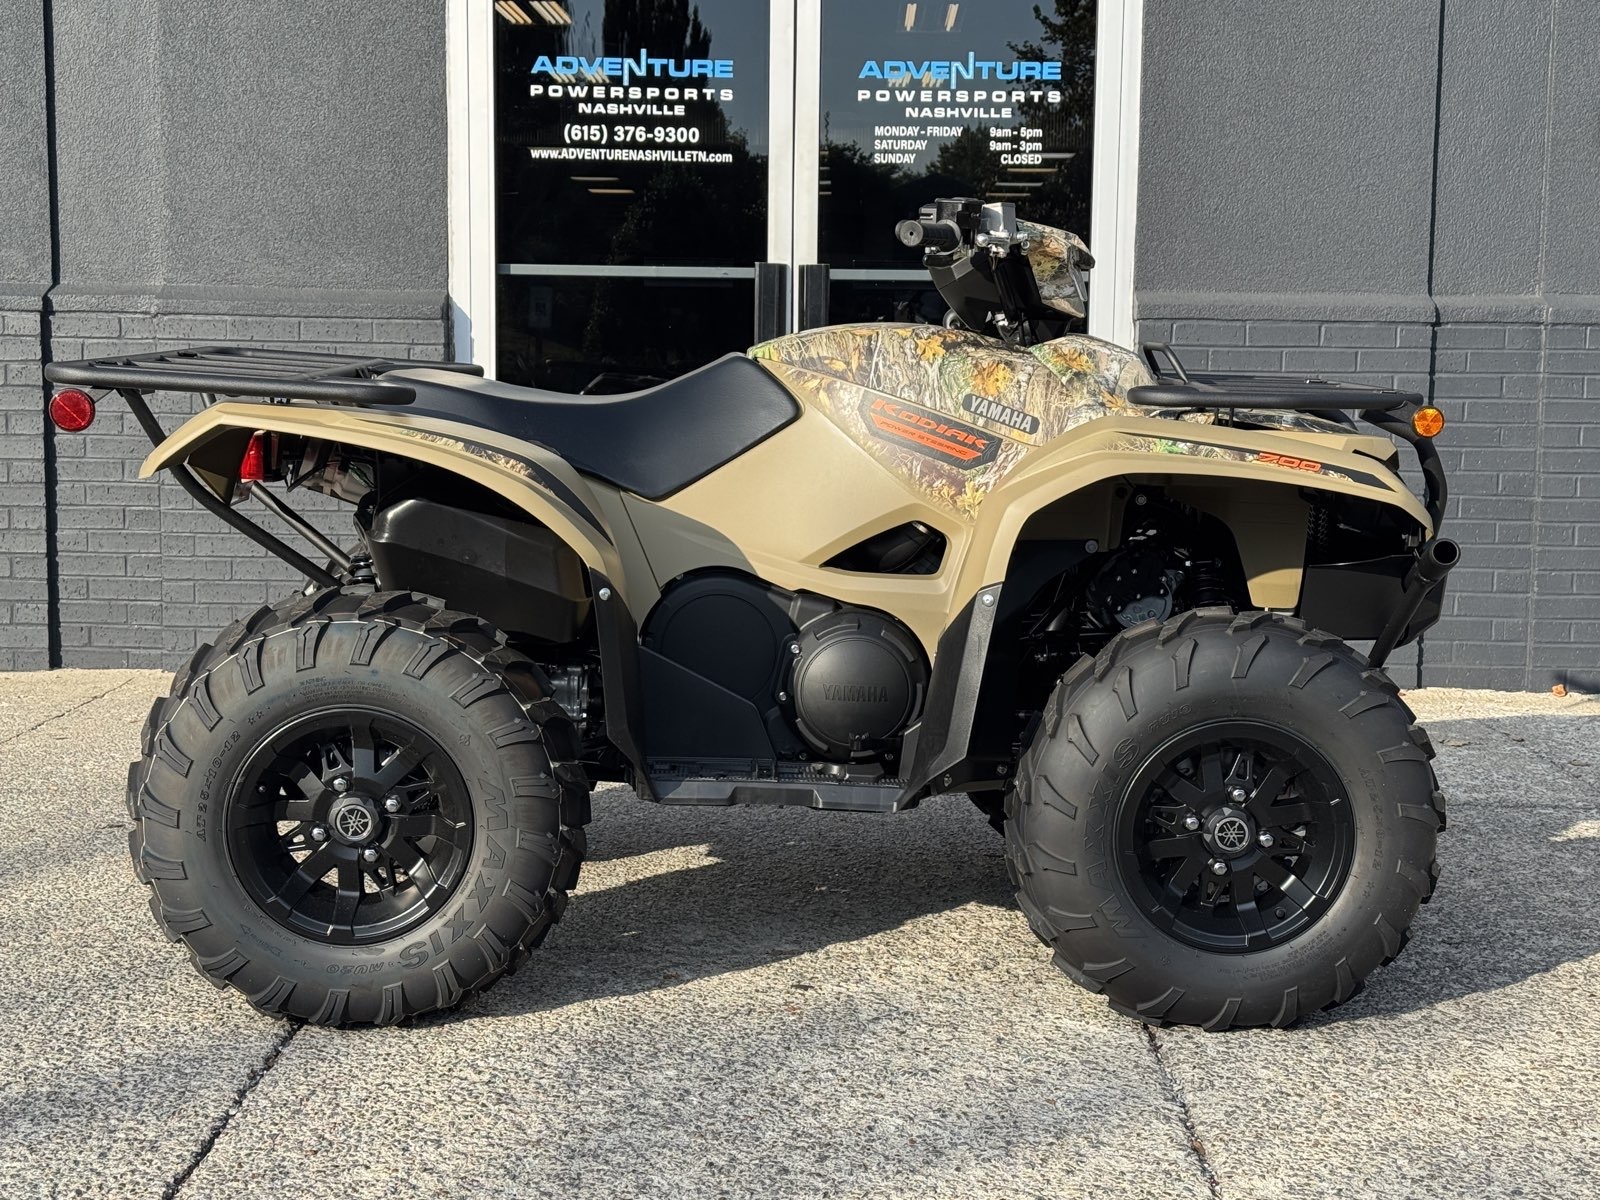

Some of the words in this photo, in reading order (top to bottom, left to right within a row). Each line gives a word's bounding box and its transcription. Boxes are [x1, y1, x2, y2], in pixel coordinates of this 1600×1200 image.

[531, 48, 733, 86] ADVENTURE
[858, 51, 1062, 89] ADVENTURE
[530, 84, 734, 101] POWERSPORTS
[857, 90, 1062, 103] POWERSPORTS
[578, 103, 686, 115] NASHVILLE
[905, 107, 1013, 118] NASHVILLE
[563, 123, 608, 144] (615)
[614, 126, 700, 143] 376-9300
[530, 148, 733, 163] www.ADVENTURENASHVILLETN.com
[874, 140, 928, 151] SATURDAY
[874, 153, 917, 164] SUNDAY
[1000, 154, 1042, 165] CLOSED
[871, 399, 990, 449] KODIAK
[970, 395, 1032, 433] YAMAHA
[880, 421, 916, 439] POWER
[917, 434, 968, 457] STEERING
[1258, 452, 1322, 473] 700
[822, 683, 889, 703] YAMAHA
[1083, 737, 1149, 939] MAXXIS
[400, 777, 508, 970] MAXXIS
